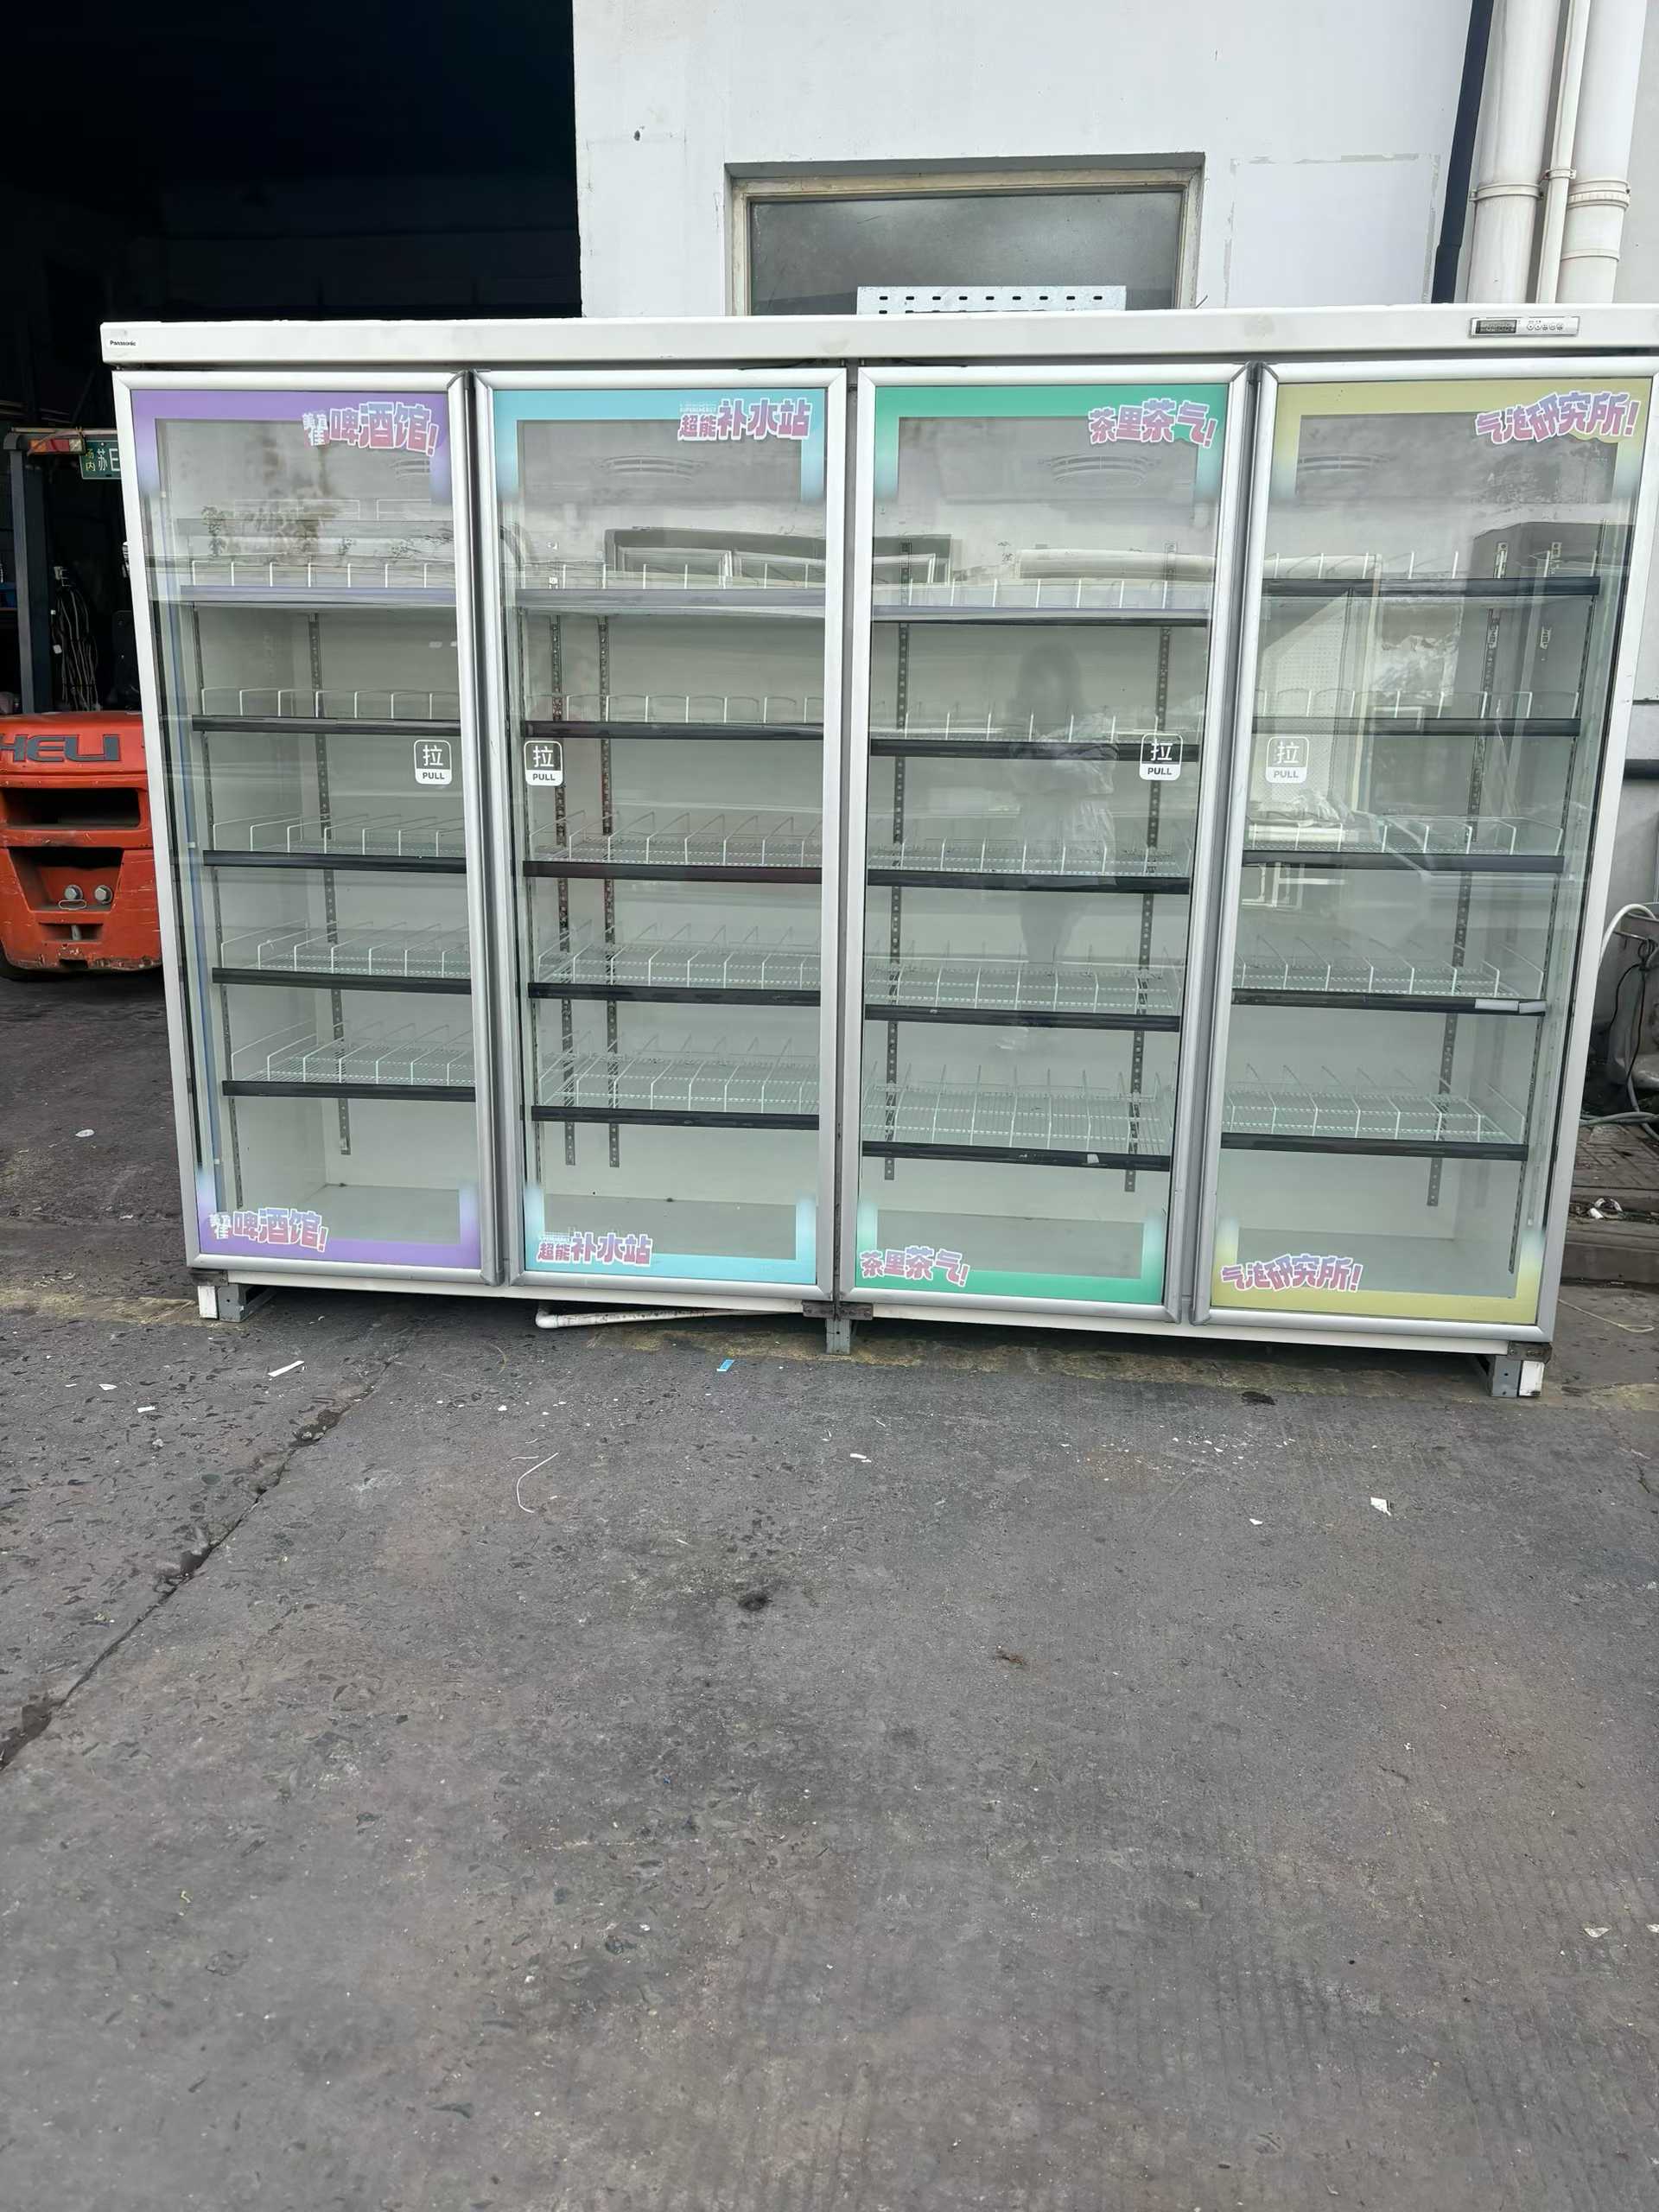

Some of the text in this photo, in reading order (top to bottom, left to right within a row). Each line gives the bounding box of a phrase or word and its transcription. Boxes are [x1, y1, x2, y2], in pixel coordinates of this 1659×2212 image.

[677, 397, 812, 442] 超能补水站
[1088, 398, 1218, 448] 茶里茶气!
[423, 745, 443, 766] 拉
[533, 746, 554, 767] 拉
[1150, 738, 1173, 761] 拉
[1276, 741, 1300, 764] 拉
[422, 772, 445, 780] PULL
[532, 772, 556, 781] PULL
[1147, 766, 1173, 776] PULL
[1274, 770, 1299, 779] PULL
[537, 1231, 653, 1268] 超能补水站
[860, 1245, 970, 1287] 茶里茶气!
